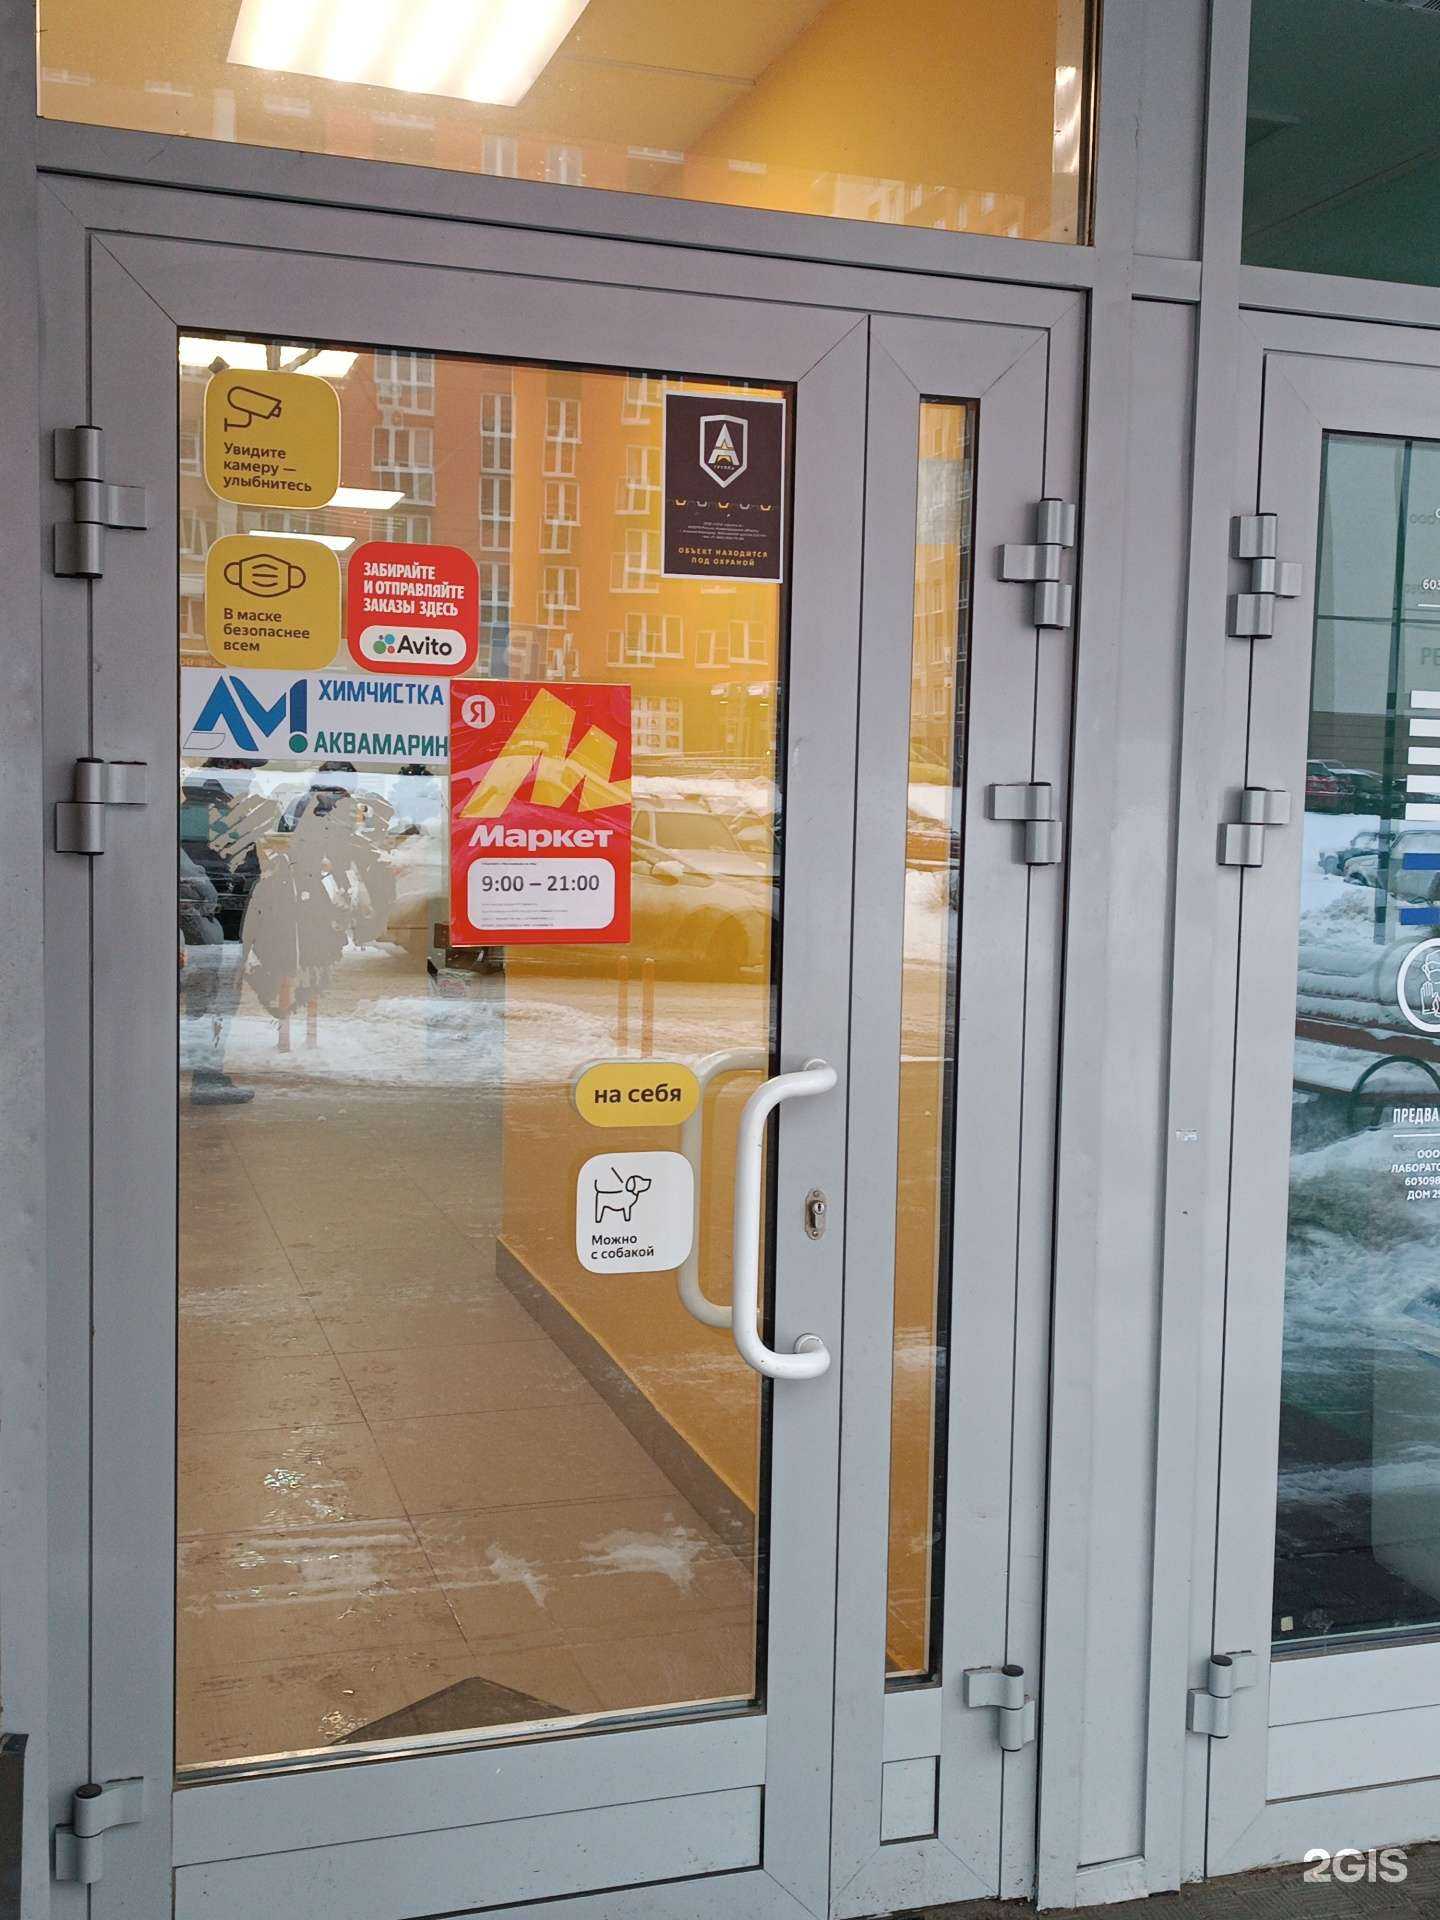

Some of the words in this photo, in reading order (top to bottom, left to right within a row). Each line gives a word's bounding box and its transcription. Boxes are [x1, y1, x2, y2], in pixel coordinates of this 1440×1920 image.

[224, 442, 287, 459] Увидите
[223, 460, 280, 476] камеру
[223, 476, 312, 492] улыбнитесь
[678, 547, 712, 556] ОБЪЕКТ
[715, 549, 768, 558] НАХОДИТСЯ
[363, 561, 436, 580] ЗАБИРАЙТЕ
[691, 557, 710, 566] ПОД
[713, 558, 755, 567] ОХРАНОЙ
[363, 580, 373, 594] И
[375, 581, 465, 599] ОТПРАВЛЯЙТЕ
[223, 607, 234, 620] В
[237, 610, 282, 622] маске
[363, 598, 415, 614] ЗАКАЗЫ
[419, 601, 459, 618] ЗДЕСЬ
[223, 623, 310, 639] безопаснее
[223, 641, 260, 651] всем
[397, 634, 452, 656] Avito
[317, 679, 445, 706] ХИМЧИСТКА
[470, 701, 486, 723] Я
[313, 731, 449, 757] АКВАМАРИН
[468, 824, 614, 852] Маркет
[482, 875, 524, 892] 9:00
[547, 874, 600, 892] 21:00
[594, 1088, 622, 1104] на
[628, 1083, 682, 1104] себя
[1393, 1107, 1440, 1125] ПРЕДВА
[1407, 1190, 1431, 1200] ДОМ
[591, 1235, 638, 1246] Можно
[591, 1251, 598, 1259] с
[601, 1246, 654, 1259] собакой
